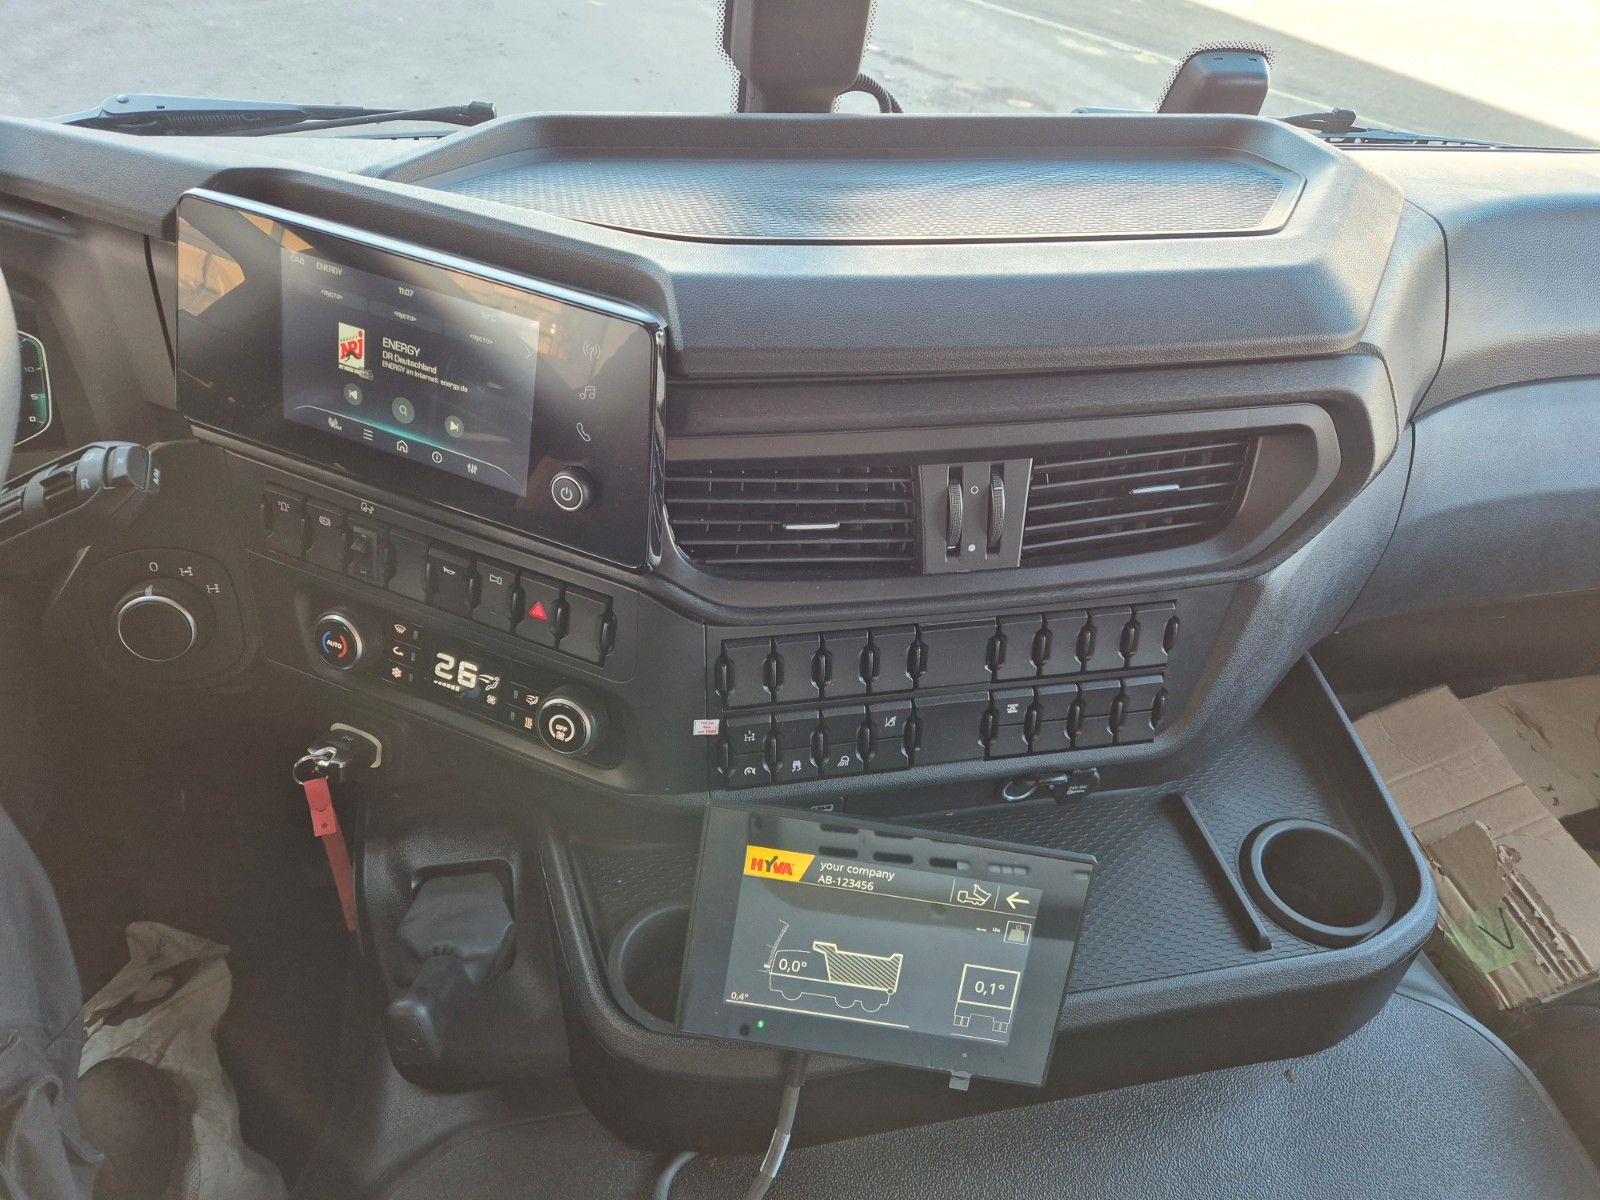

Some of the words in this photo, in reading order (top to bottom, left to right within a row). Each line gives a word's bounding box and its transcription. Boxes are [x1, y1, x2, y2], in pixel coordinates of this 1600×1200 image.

[316, 261, 343, 276] ENERGY
[398, 286, 414, 297] 11:07
[382, 337, 421, 357] ENERGY
[394, 354, 437, 374] Deutschland
[382, 360, 405, 374] ENERGY
[440, 379, 468, 393] energy.de
[80, 478, 91, 490] R
[326, 639, 342, 650] AUTO
[434, 652, 479, 689] 26
[555, 723, 568, 732] OFF
[751, 855, 794, 876] HYVA
[819, 861, 845, 872] your
[846, 864, 896, 882] company
[817, 874, 874, 892] AB-123456
